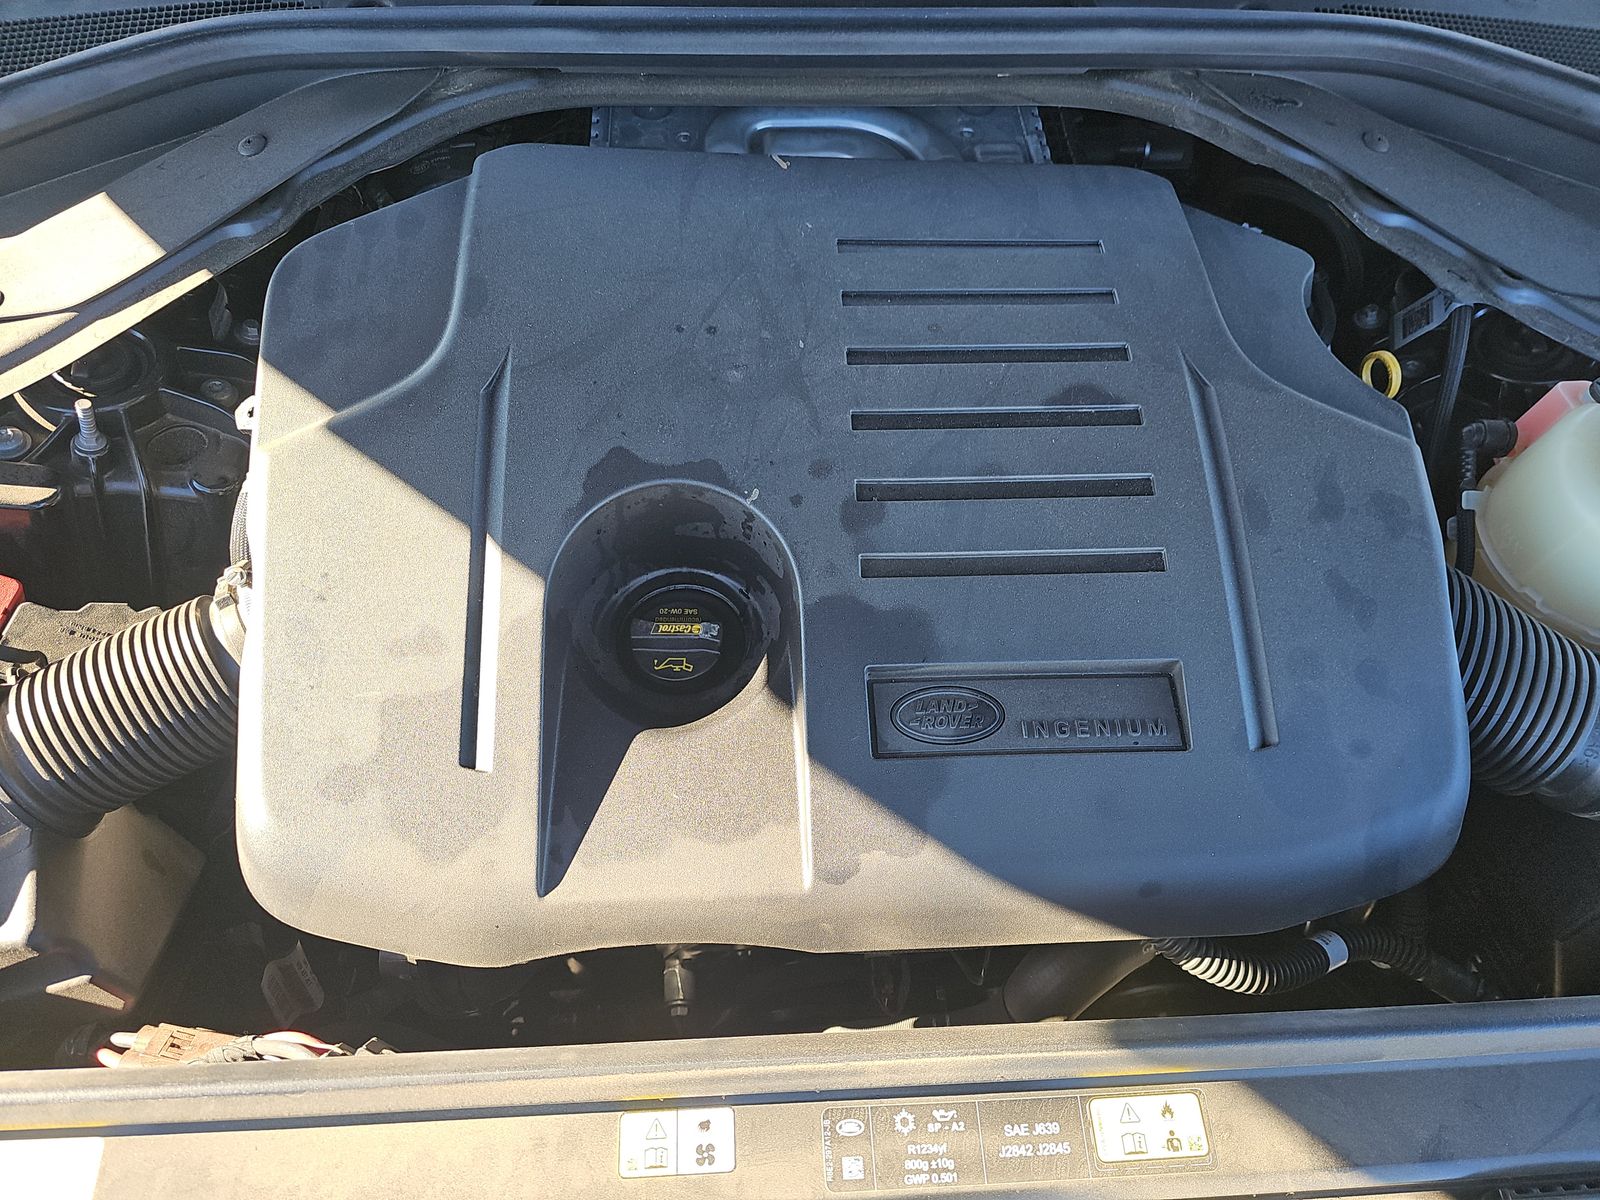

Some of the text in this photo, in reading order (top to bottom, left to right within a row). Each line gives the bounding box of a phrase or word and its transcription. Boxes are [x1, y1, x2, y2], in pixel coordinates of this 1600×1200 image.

[658, 624, 692, 634] Castrol
[914, 696, 967, 715] LAND
[920, 713, 985, 730] ROVER
[1020, 717, 1168, 740] INGENIUM
[1003, 1121, 1061, 1137] SAE J639
[907, 1142, 948, 1155] R1234yf
[998, 1141, 1072, 1158] J2842 J2845
[903, 1172, 958, 1185] GWP 0.501
